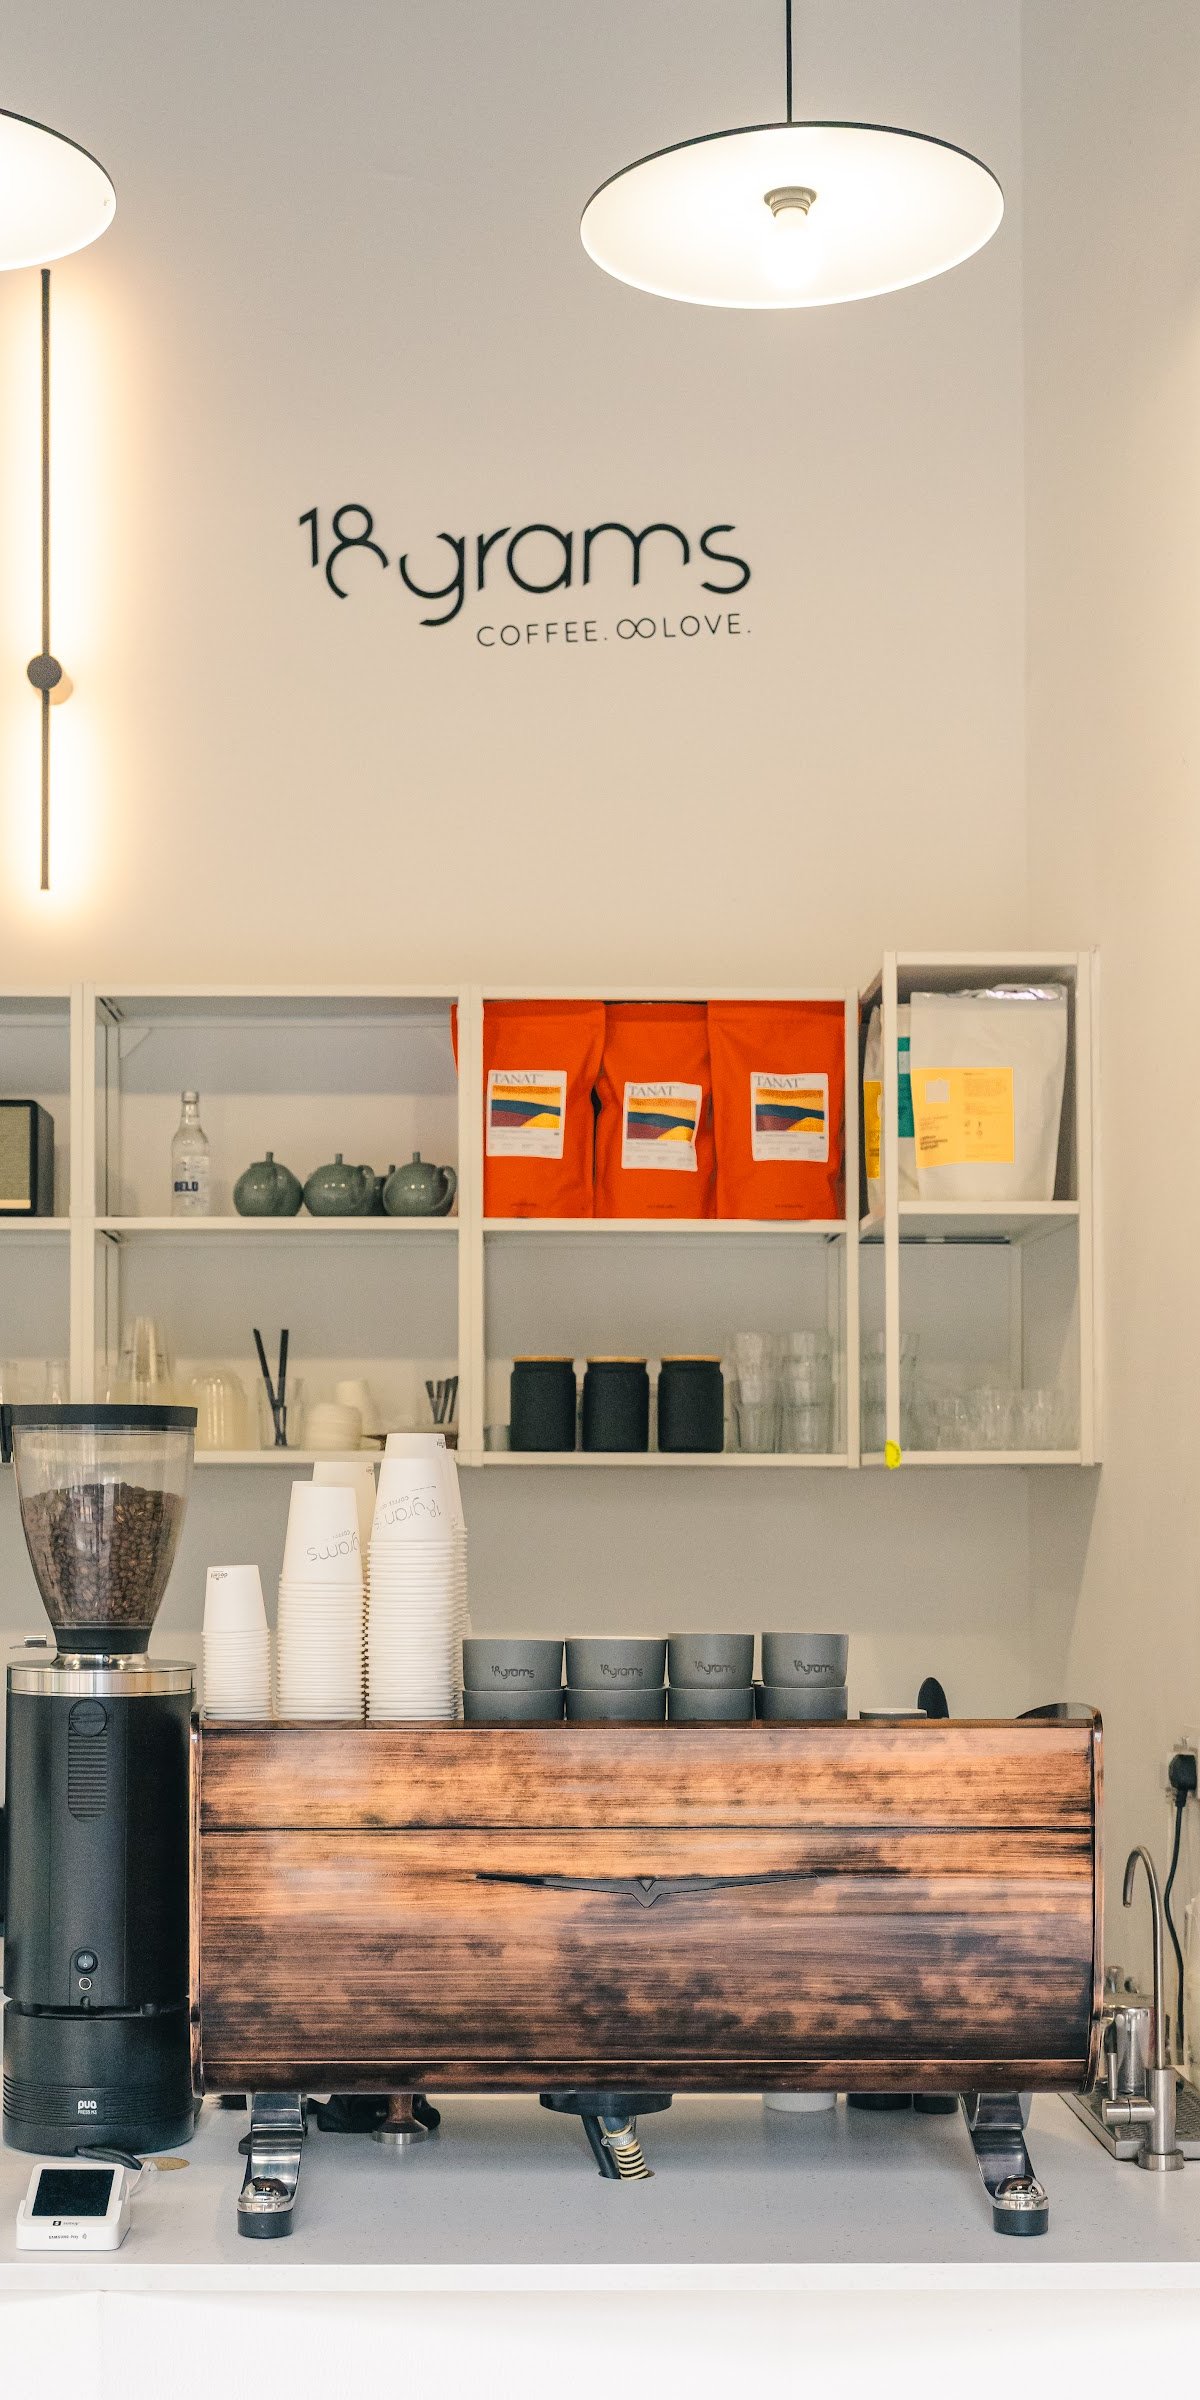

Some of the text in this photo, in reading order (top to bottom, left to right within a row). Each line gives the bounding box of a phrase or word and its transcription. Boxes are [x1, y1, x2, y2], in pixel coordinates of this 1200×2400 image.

[298, 503, 752, 627] 18grams
[492, 1073, 540, 1084] TANAT
[754, 1075, 801, 1089] TANAT
[629, 1085, 675, 1097] TANAT
[491, 1664, 535, 1679] 18grams
[600, 1663, 644, 1678] 18grams
